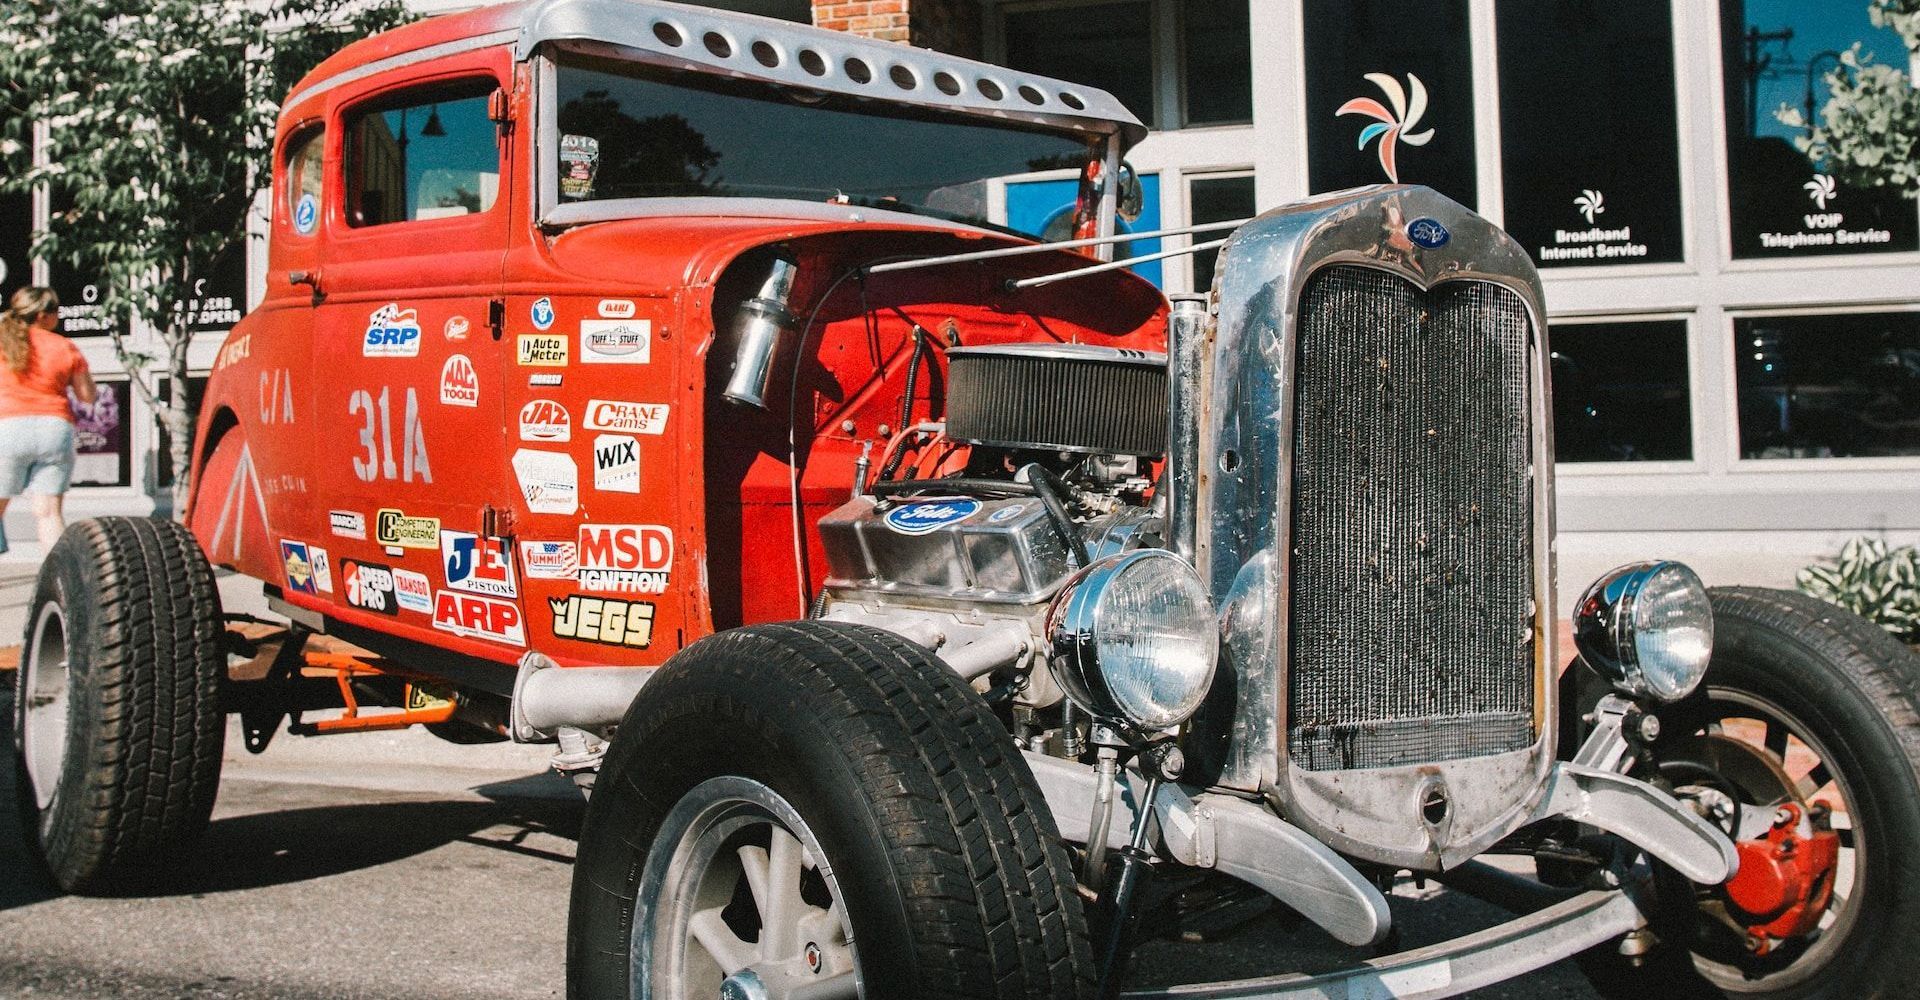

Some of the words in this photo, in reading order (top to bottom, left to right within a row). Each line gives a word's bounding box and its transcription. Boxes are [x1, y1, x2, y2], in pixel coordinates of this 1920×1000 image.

[561, 135, 598, 149] 2014
[1804, 213, 1843, 229] VOIP
[1414, 222, 1444, 243] Ford
[1555, 226, 1631, 243] Broadband
[1760, 231, 1834, 249] Telephone
[1836, 229, 1890, 245] Service
[1540, 244, 1594, 260] Internet
[1596, 242, 1647, 258] Service
[366, 328, 419, 345] SRP
[532, 338, 560, 349] Auto
[592, 335, 607, 344] TUFF
[619, 335, 639, 344] STUFF
[529, 349, 566, 363] Meter
[259, 368, 295, 424] C/A
[444, 388, 475, 401] TOOLS
[522, 402, 568, 425] JAZ
[593, 403, 662, 427] CRANE
[349, 385, 433, 484] 31A
[597, 440, 636, 470] WIX
[395, 529, 436, 540] ENGINEERING
[527, 548, 561, 566] SUMMIT
[579, 528, 670, 569] MSD
[448, 536, 506, 583] JE
[358, 565, 393, 592] SPEED
[396, 574, 428, 596] TRANSGO
[467, 579, 516, 595] PISTONS
[579, 570, 670, 593] IGNITION
[361, 585, 386, 611] PRO
[436, 595, 518, 635] ARP
[550, 596, 655, 648] JEGS
